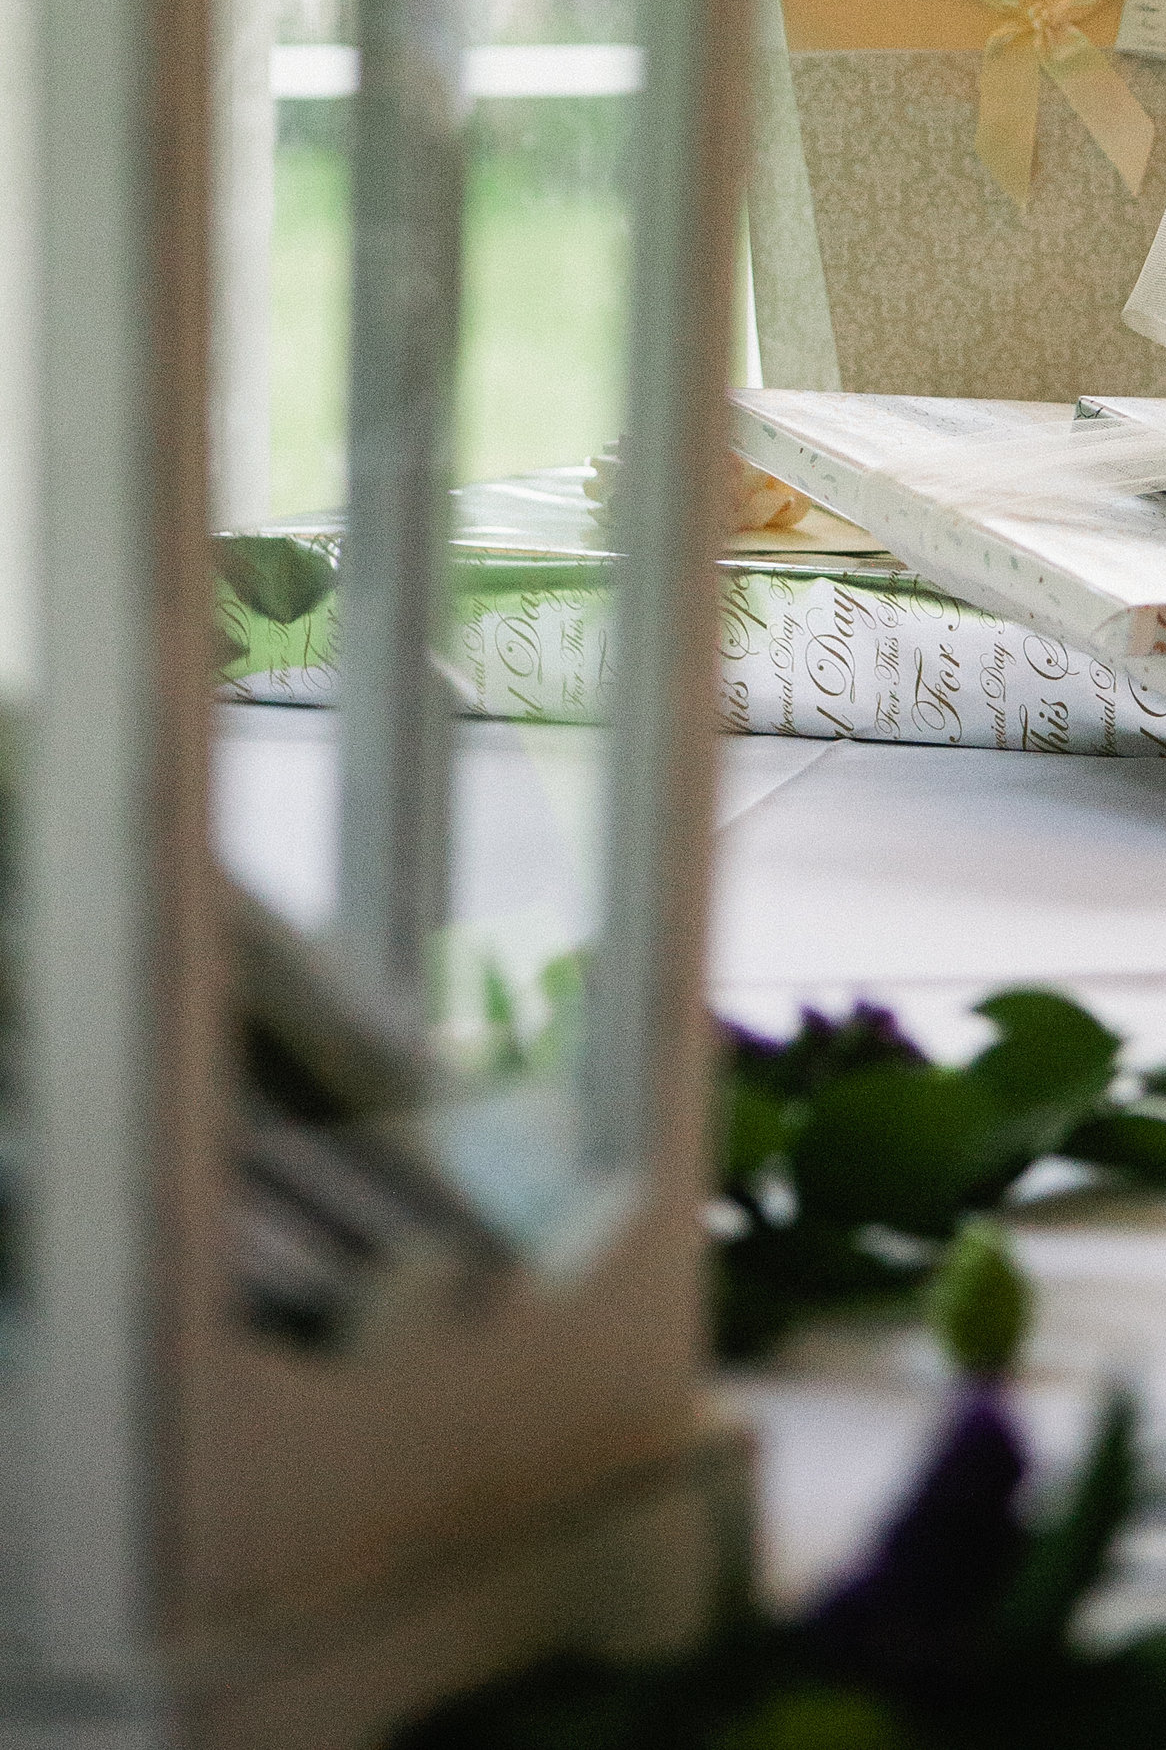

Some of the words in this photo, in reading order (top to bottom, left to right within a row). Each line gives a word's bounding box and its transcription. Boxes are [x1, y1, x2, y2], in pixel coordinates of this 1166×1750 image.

[768, 613, 805, 673] Day
[804, 583, 878, 704] Day
[874, 636, 900, 686] This
[979, 642, 1017, 703] Day
[873, 691, 901, 740] For
[910, 643, 963, 743] For
